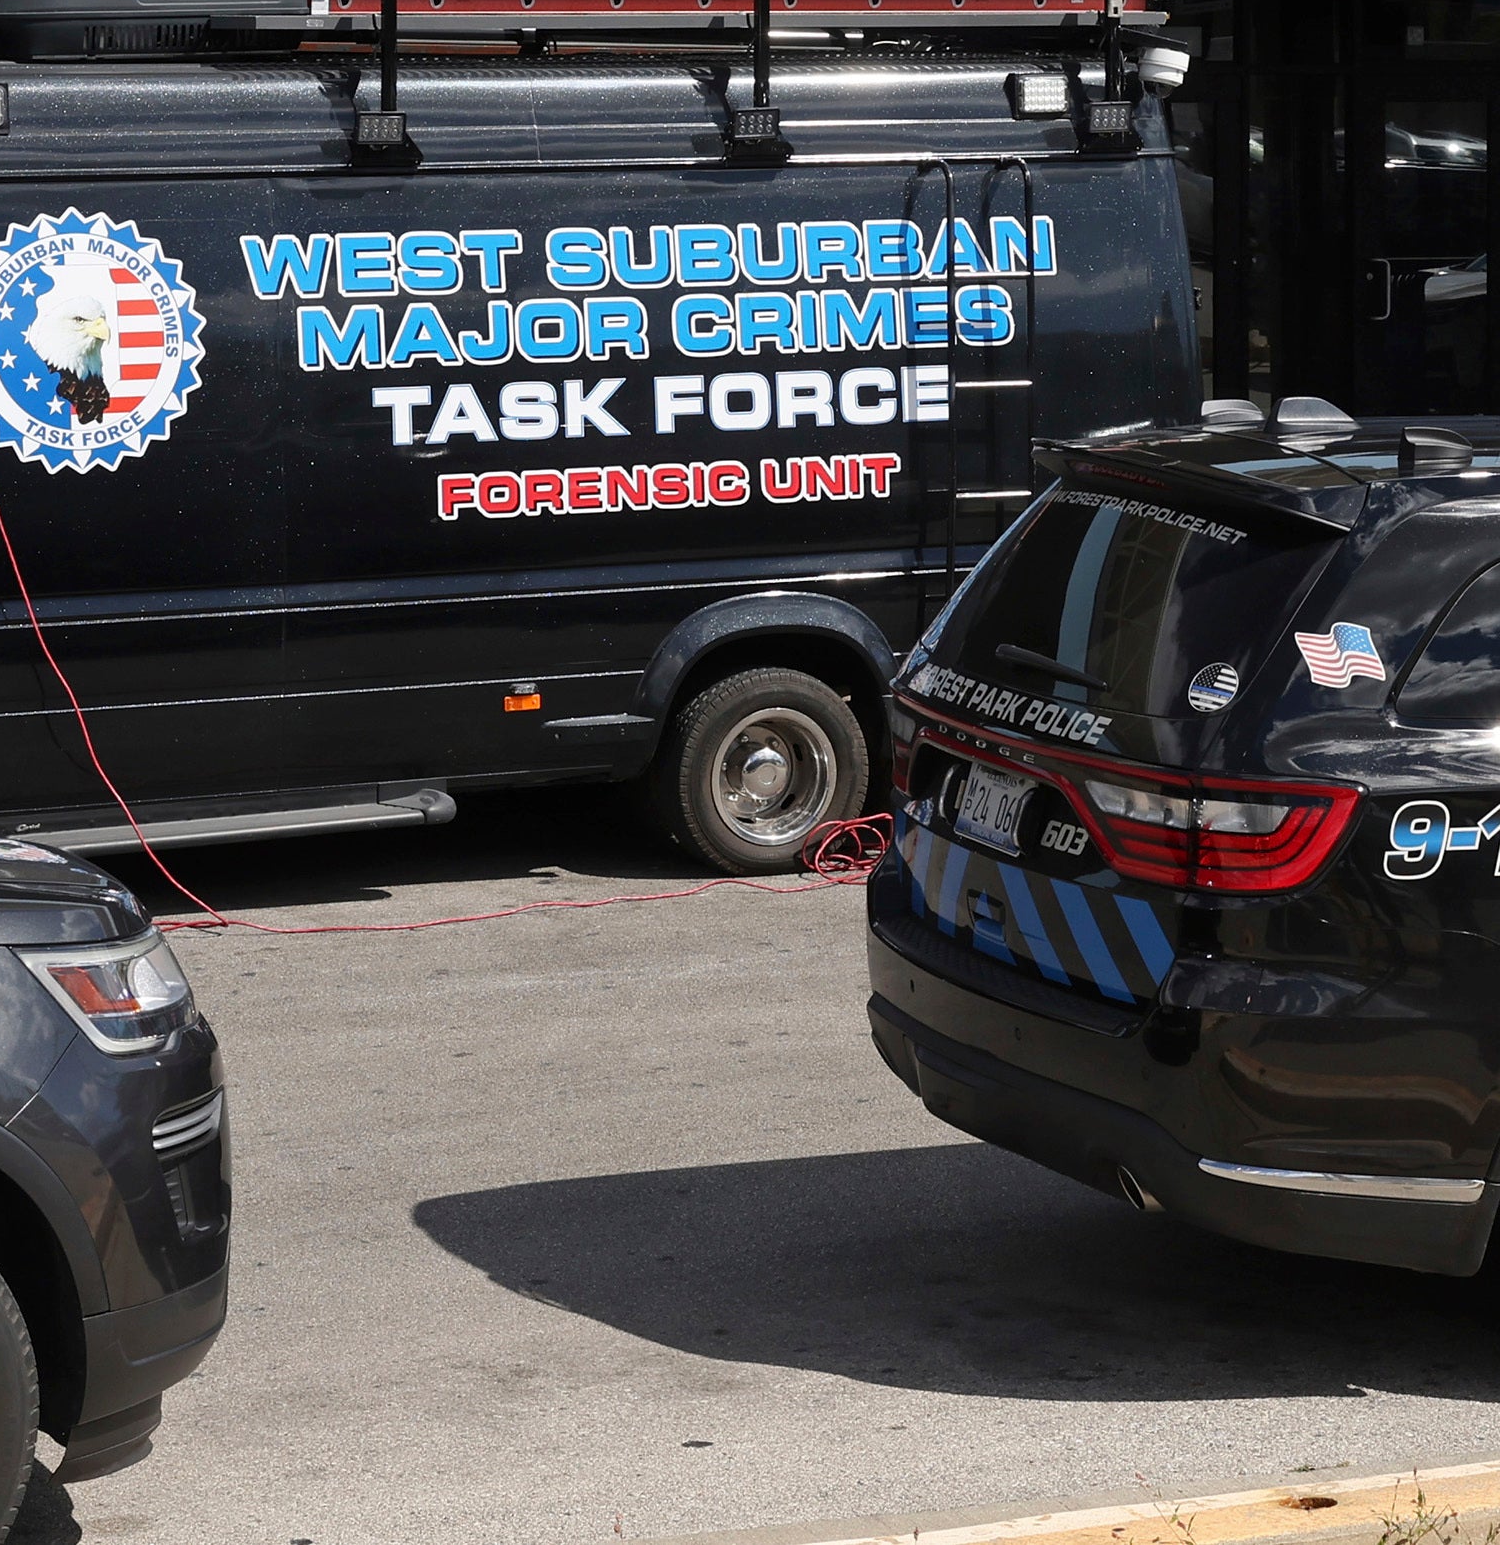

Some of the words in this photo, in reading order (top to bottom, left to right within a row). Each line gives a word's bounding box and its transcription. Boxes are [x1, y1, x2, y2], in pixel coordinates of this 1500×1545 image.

[239, 228, 522, 300] WEST
[545, 215, 1057, 289] SUBURBAN
[87, 238, 151, 282] MAJOR
[150, 283, 179, 358] CRIMES
[296, 293, 649, 371] MAJOR
[671, 283, 1015, 357] CRIMES
[25, 419, 75, 446] TASK
[83, 411, 145, 446] FORCE
[372, 376, 631, 446] TASK
[655, 365, 957, 435] FORCE
[436, 459, 751, 521] FORENSIC
[760, 453, 901, 503] UNIT
[938, 724, 1035, 764] DODGE
[967, 683, 1028, 723] PARK
[1020, 699, 1113, 746] POLICE
[1040, 819, 1089, 856] 603
